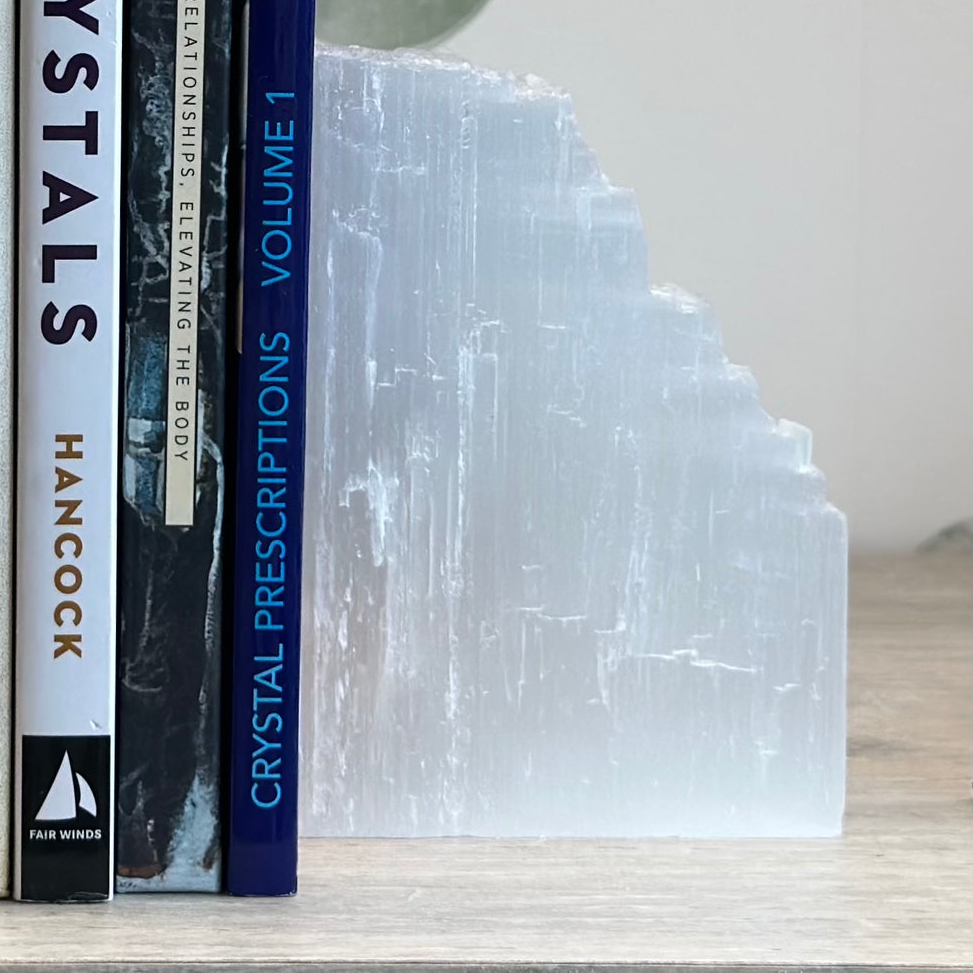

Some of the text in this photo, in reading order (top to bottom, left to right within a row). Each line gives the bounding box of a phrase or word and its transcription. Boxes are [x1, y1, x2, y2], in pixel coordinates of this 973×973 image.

[261, 92, 295, 286] VOLUME 1
[176, 202, 195, 331] ELEVATING
[175, 346, 190, 386] THE
[173, 402, 189, 461] BODY
[53, 433, 83, 659] HANCOCK
[250, 332, 290, 809] CRYSTAL PRESCRIPTIONS
[29, 829, 102, 840] FAIR WINDS
